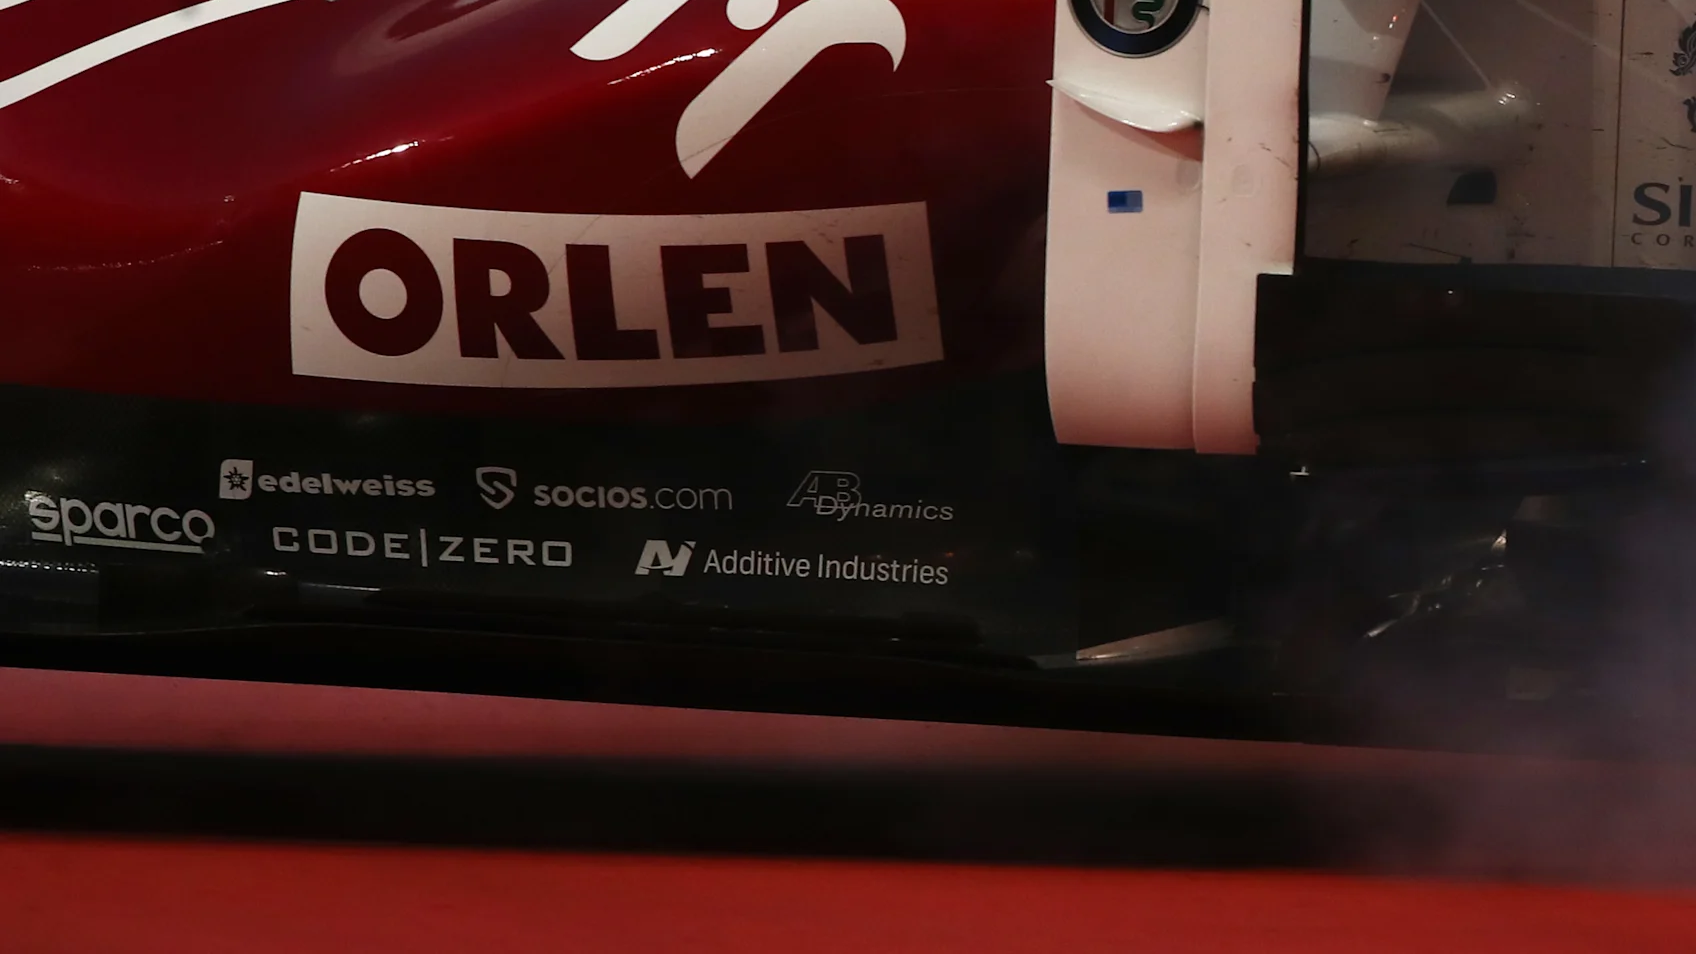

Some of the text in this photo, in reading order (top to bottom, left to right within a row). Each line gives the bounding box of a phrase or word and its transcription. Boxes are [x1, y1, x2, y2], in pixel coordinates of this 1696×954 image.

[325, 228, 898, 361] ORLEN
[257, 472, 436, 496] edelweiss
[29, 495, 215, 546] sparco
[816, 495, 954, 521] Dynamics
[703, 549, 949, 585] Additive Industries
